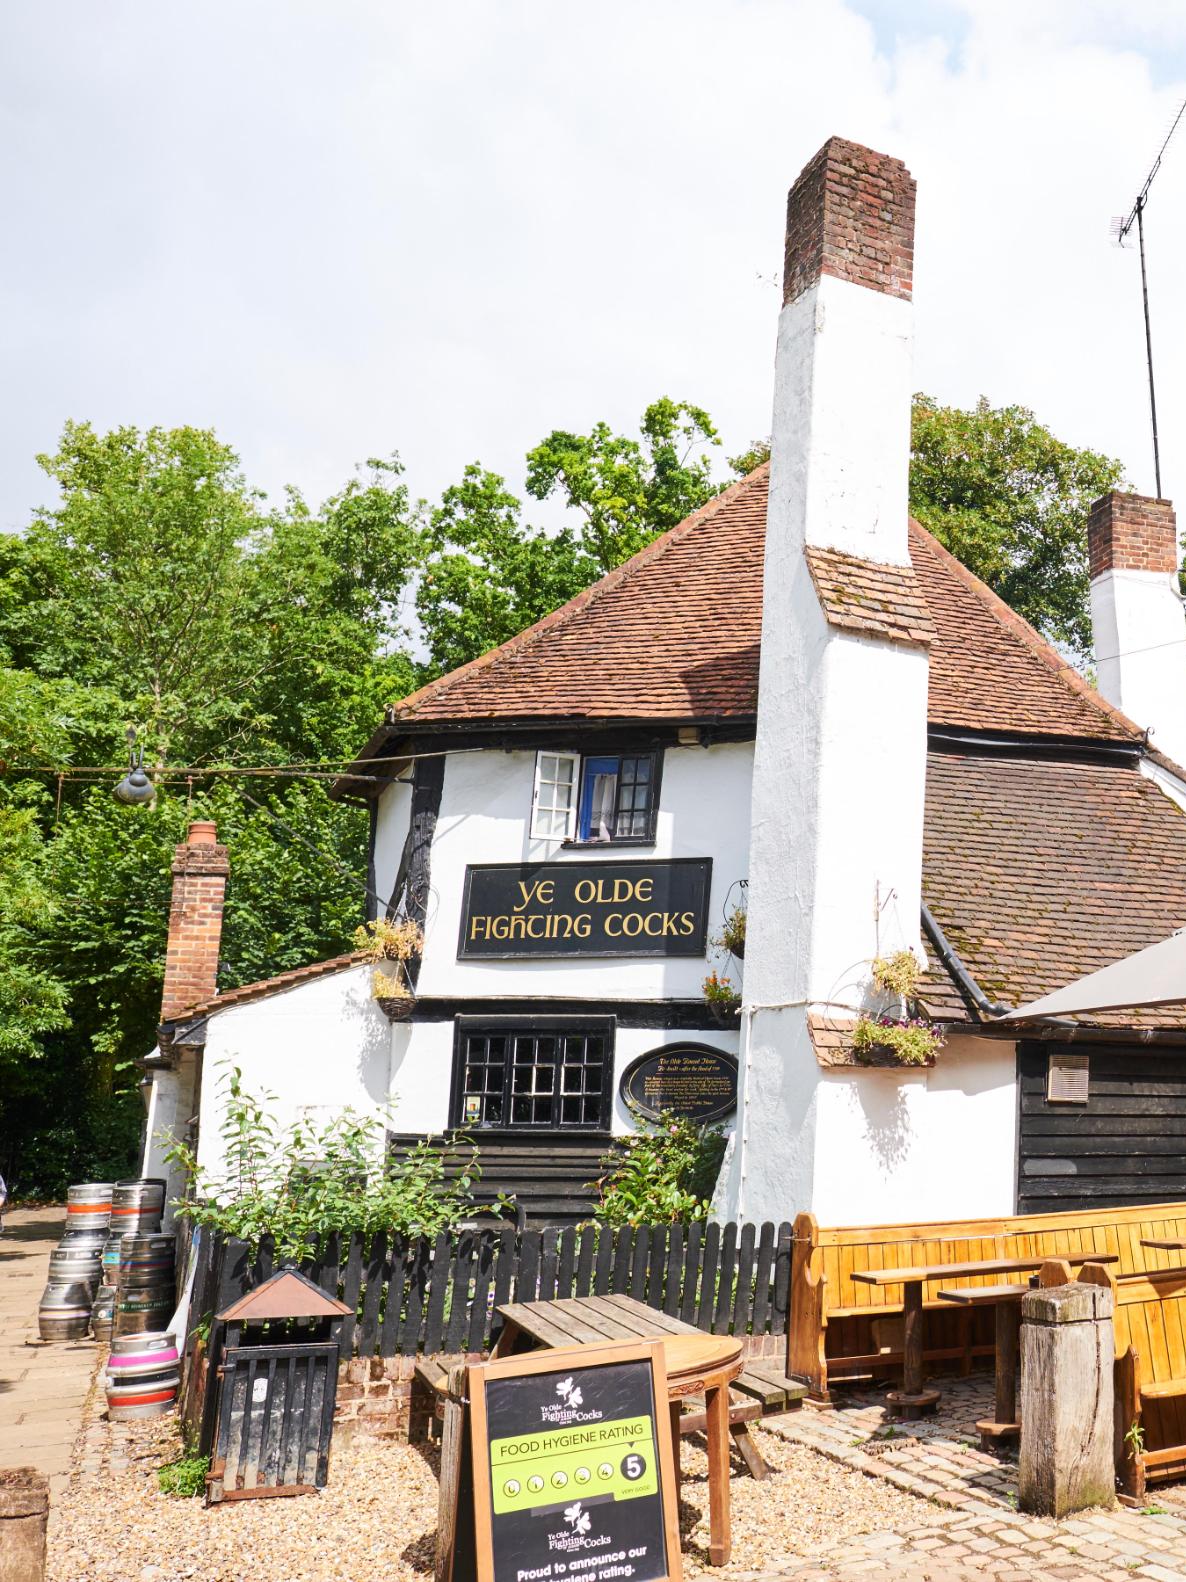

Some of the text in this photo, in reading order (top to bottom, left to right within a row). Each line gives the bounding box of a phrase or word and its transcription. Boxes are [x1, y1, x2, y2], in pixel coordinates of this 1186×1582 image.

[513, 878, 654, 912] YE OLDE
[470, 912, 695, 940] FIGHTING COCKS
[542, 1409, 577, 1421] Fighting
[576, 1409, 603, 1421] Cocks
[500, 1424, 644, 1457] FOOD HYGIENE RATING
[626, 1456, 641, 1478] 5
[549, 1535, 584, 1550] Fighting
[584, 1535, 611, 1548] Cocks
[556, 1530, 570, 1538] Olde
[517, 1546, 647, 1582] Proud to announce our
[598, 1564, 635, 1579] rating.
